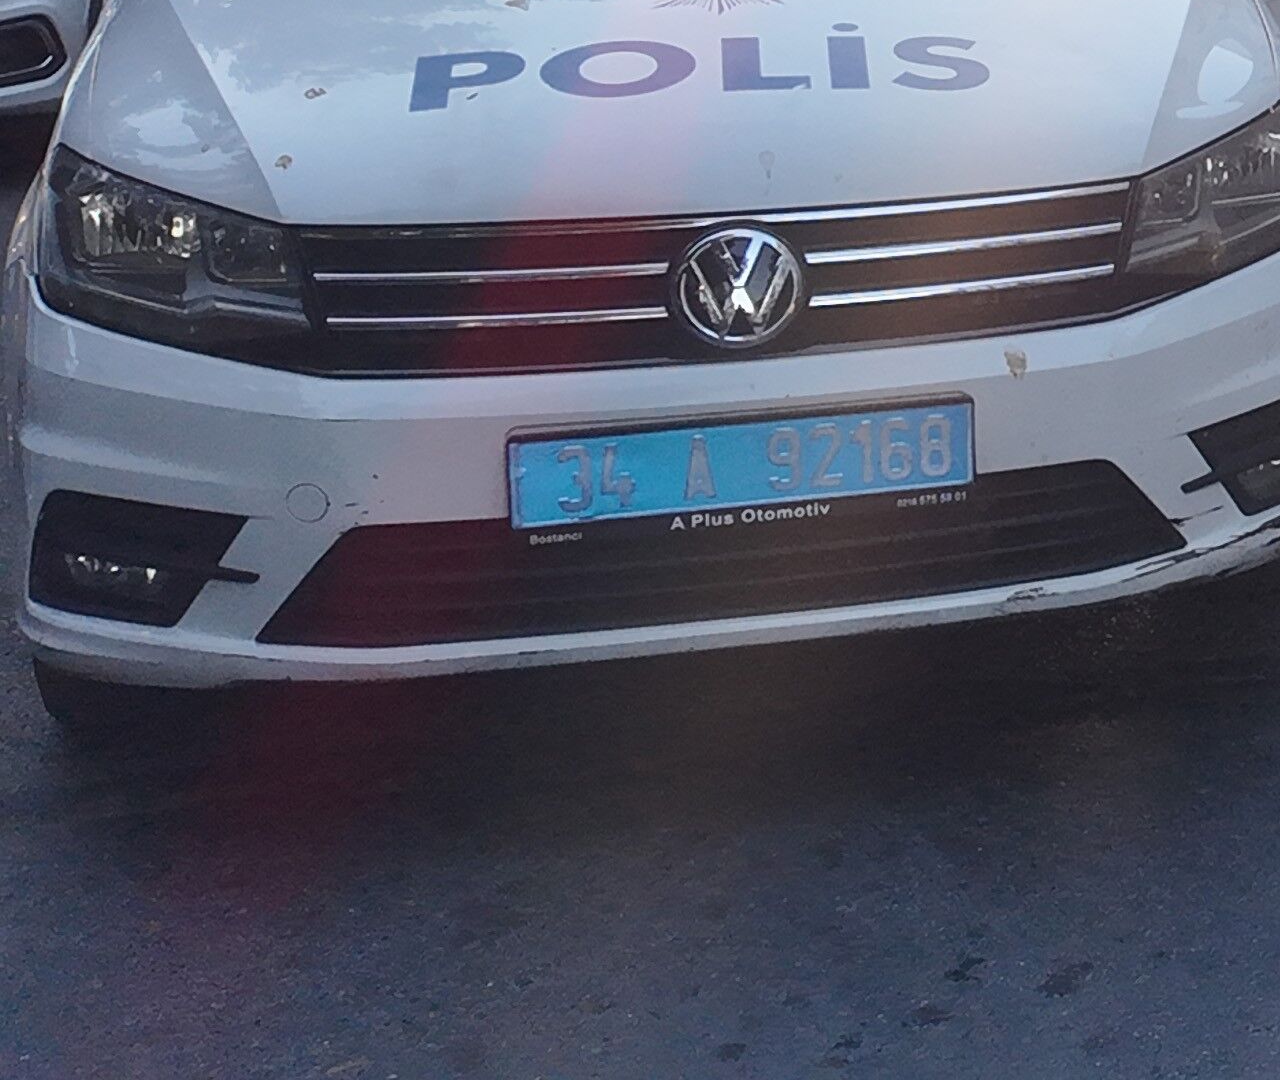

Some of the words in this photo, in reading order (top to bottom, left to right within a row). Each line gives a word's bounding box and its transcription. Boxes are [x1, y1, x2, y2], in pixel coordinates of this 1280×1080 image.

[409, 22, 991, 113] POLİS
[556, 442, 636, 513] 34
[683, 433, 717, 500] A
[766, 413, 952, 491] 92168
[670, 517, 686, 531] A
[690, 511, 735, 528] Plus
[740, 502, 831, 525] Otomotiv
